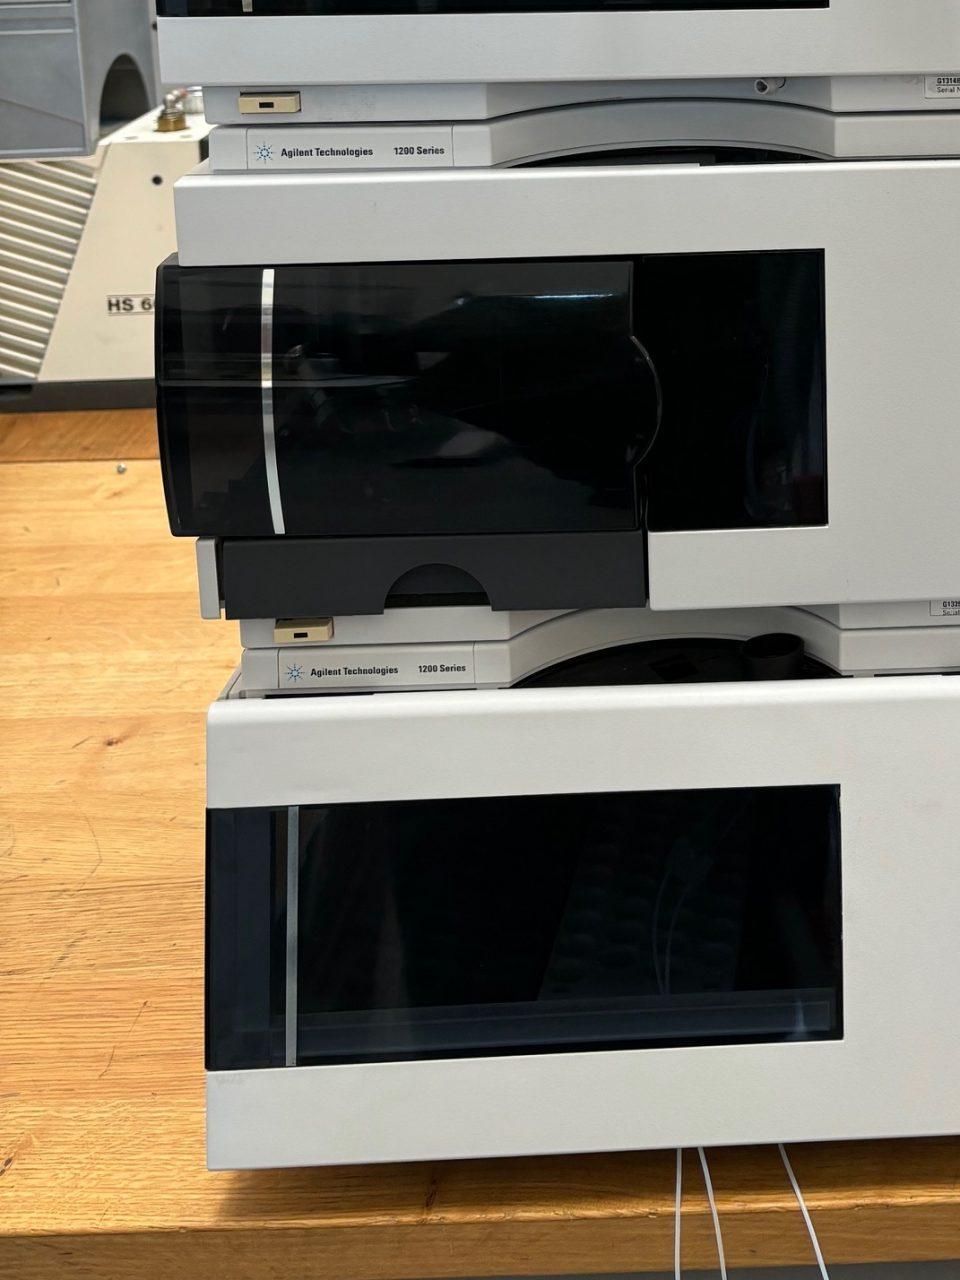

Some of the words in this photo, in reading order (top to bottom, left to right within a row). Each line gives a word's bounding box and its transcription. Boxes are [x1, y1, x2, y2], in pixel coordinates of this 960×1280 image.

[281, 147, 313, 159] Agilent
[315, 147, 373, 158] Technologies
[393, 146, 415, 155] 1200
[417, 146, 445, 155] Series
[107, 297, 134, 311] HS
[310, 667, 341, 677] Agilent
[344, 666, 399, 676] Technologies
[418, 665, 438, 673] 1200
[440, 664, 466, 673] Series
